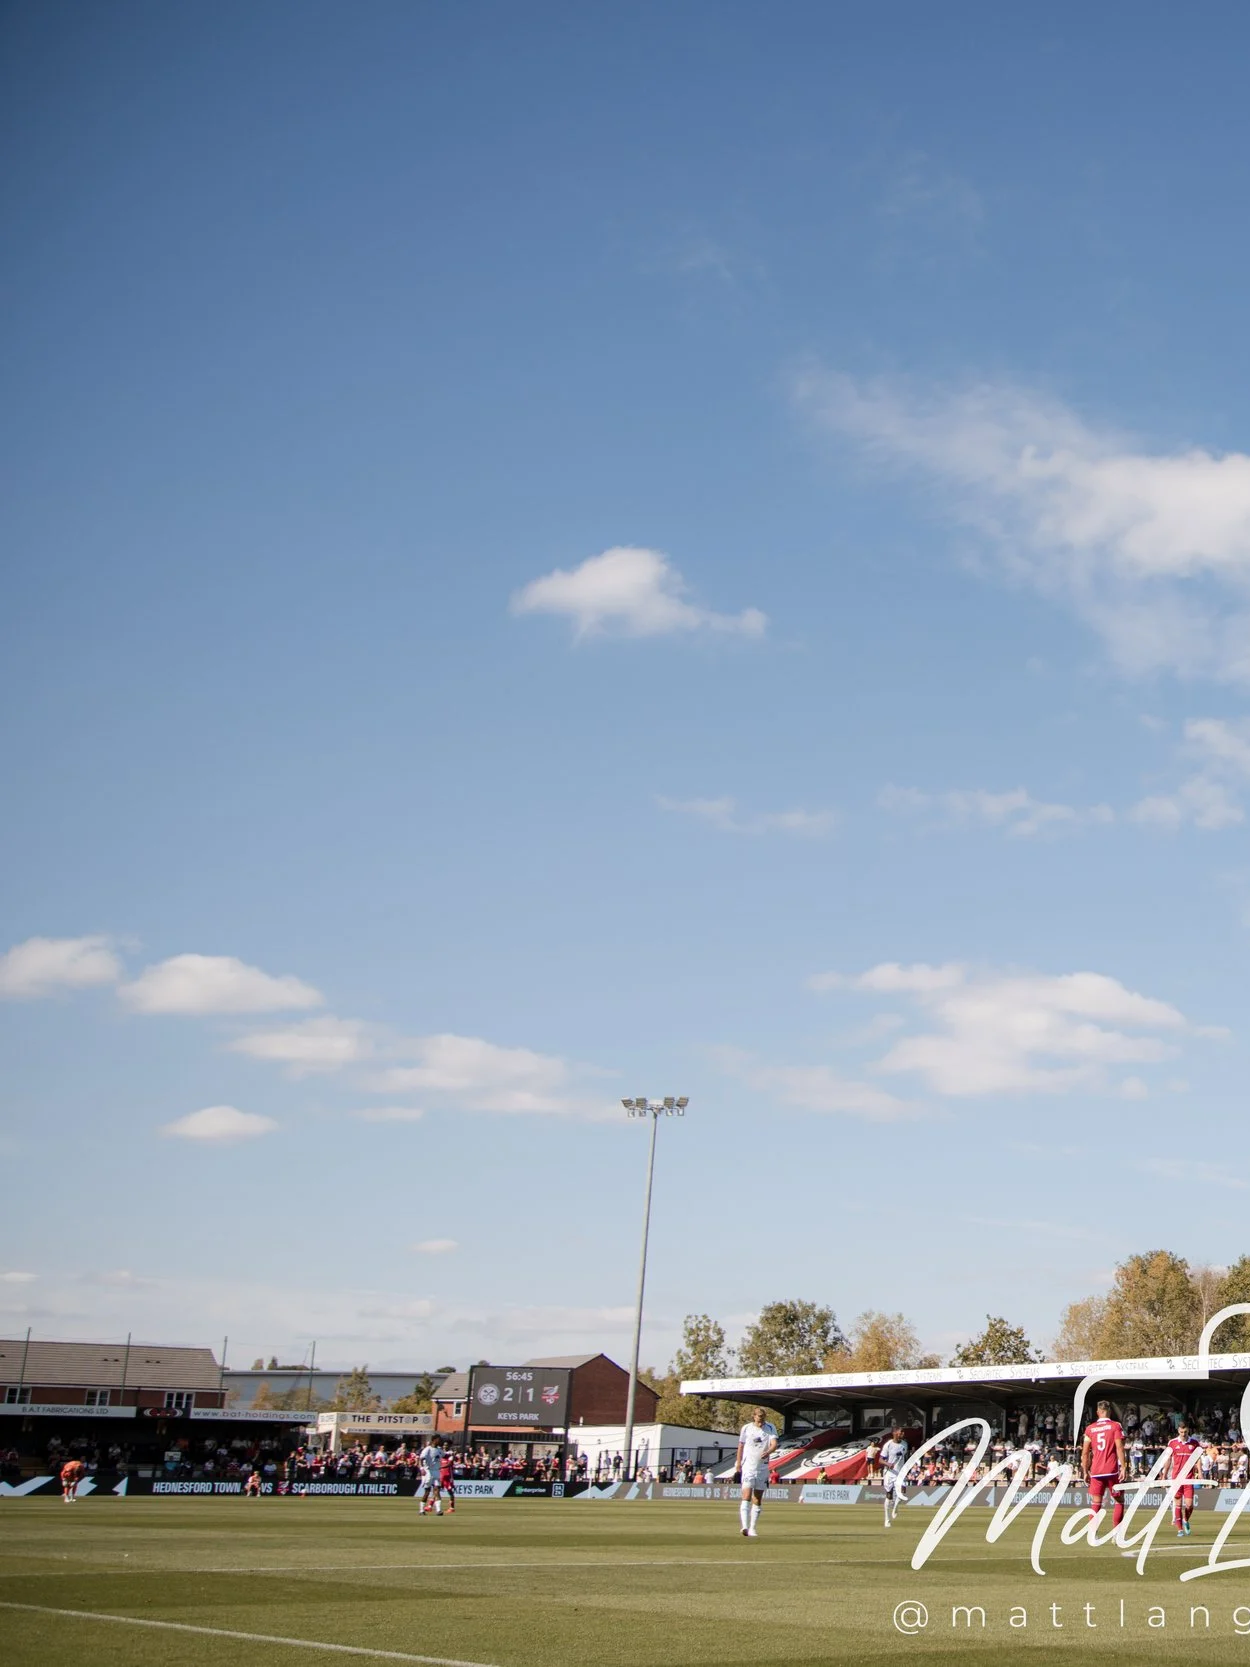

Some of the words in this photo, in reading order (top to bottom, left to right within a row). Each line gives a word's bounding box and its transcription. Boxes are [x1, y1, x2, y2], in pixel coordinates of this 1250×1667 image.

[506, 1372, 533, 1381] 56:45
[503, 1388, 513, 1401] 2
[526, 1388, 534, 1402] 1
[42, 1406, 94, 1414] FABRICATIONS
[194, 1410, 316, 1420] www.bat-holdings.com
[352, 1415, 371, 1423] THE
[498, 1412, 518, 1420] KEYS
[1097, 1432, 1106, 1451] 5
[152, 1482, 212, 1493] HEDNESFORD
[214, 1482, 241, 1493] TOWN
[292, 1482, 356, 1494] SCARBOROUGH
[357, 1484, 398, 1494] ATHLETIC
[453, 1485, 472, 1495] KEYS
[474, 1485, 494, 1495] PARK
[822, 1490, 836, 1499] KEYS
[837, 1490, 849, 1500] PARK
